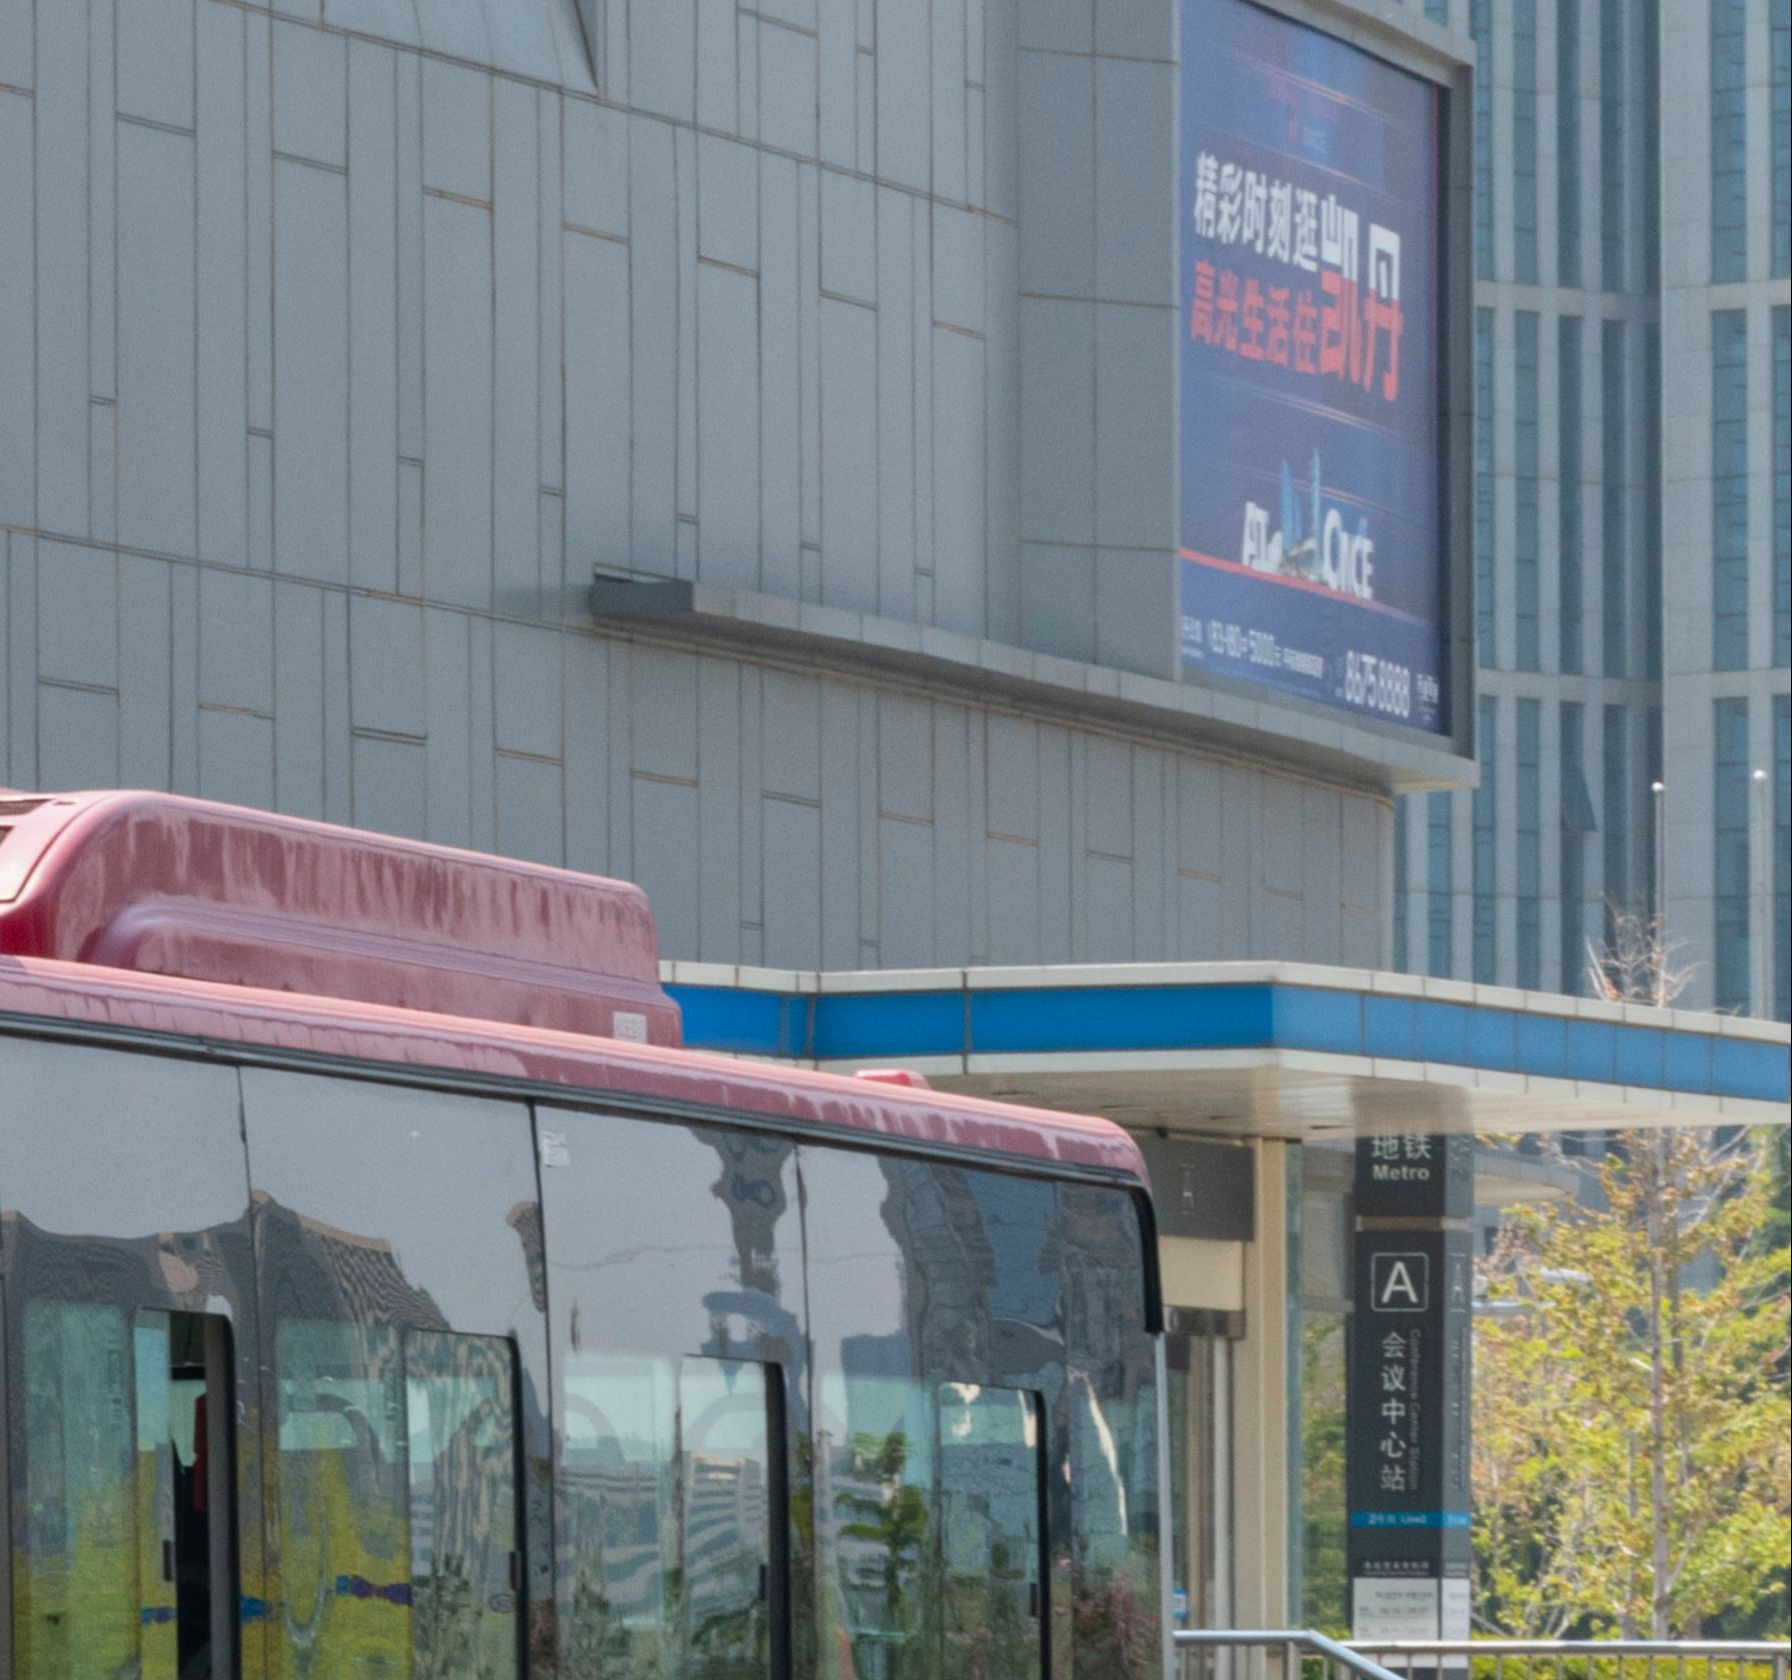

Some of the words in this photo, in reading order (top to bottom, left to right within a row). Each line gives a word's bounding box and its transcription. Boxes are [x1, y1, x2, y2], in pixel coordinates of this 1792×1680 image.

[1372, 1134, 1432, 1160] 地铁
[1373, 1165, 1429, 1181] Metro
[1381, 1261, 1419, 1303] A
[1380, 1331, 1407, 1492] 会议中心站
